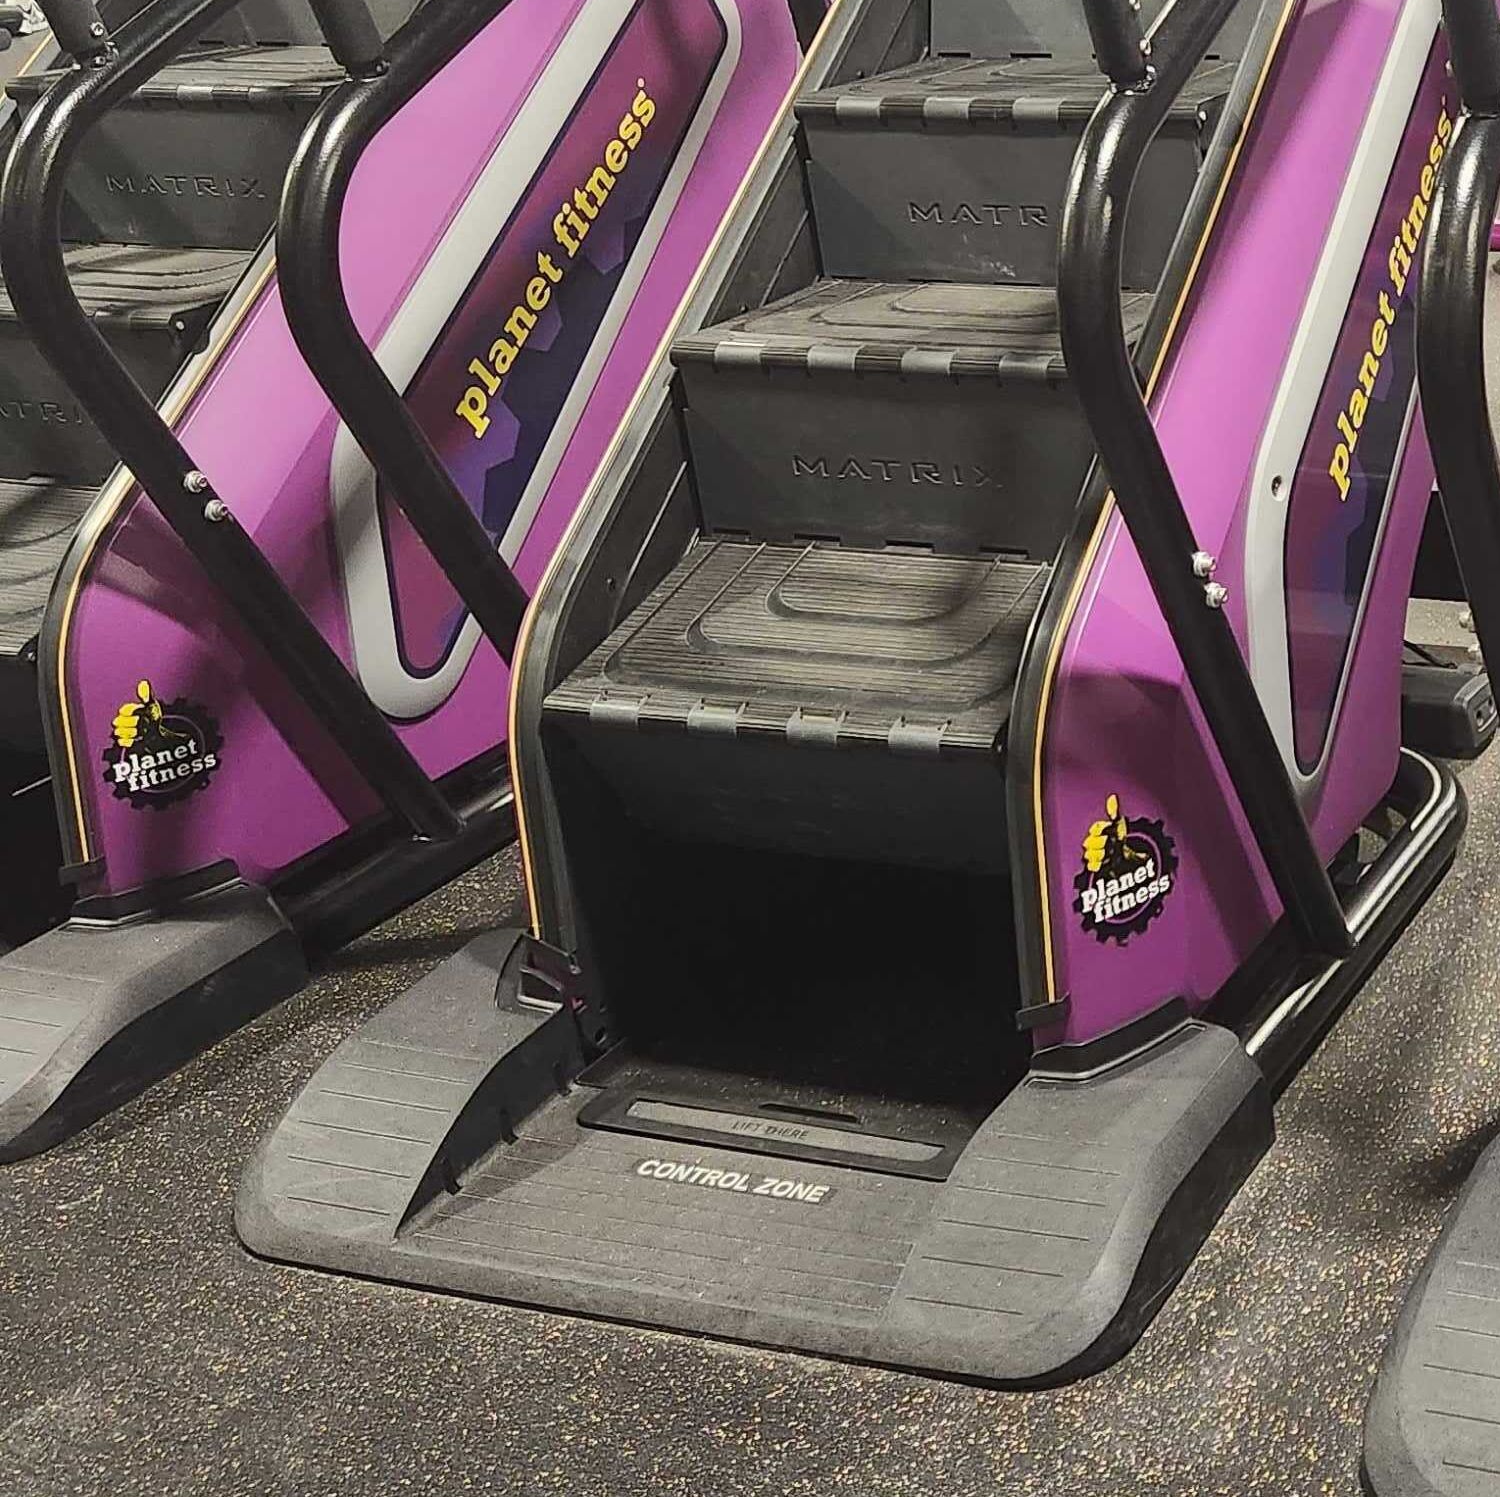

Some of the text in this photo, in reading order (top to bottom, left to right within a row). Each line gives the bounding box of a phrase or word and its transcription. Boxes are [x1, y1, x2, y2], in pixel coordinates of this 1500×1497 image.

[104, 173, 266, 199] MATRIX
[908, 201, 1049, 227] MATR
[456, 89, 657, 440] planet fitness
[1328, 106, 1453, 503] planet fitness
[791, 454, 1005, 489] MATRIX
[112, 738, 198, 783] planet
[127, 753, 217, 792] fitness
[1081, 857, 1156, 914] planet
[1093, 873, 1171, 923] fitness
[636, 1159, 830, 1203] CONTROL ZONE
